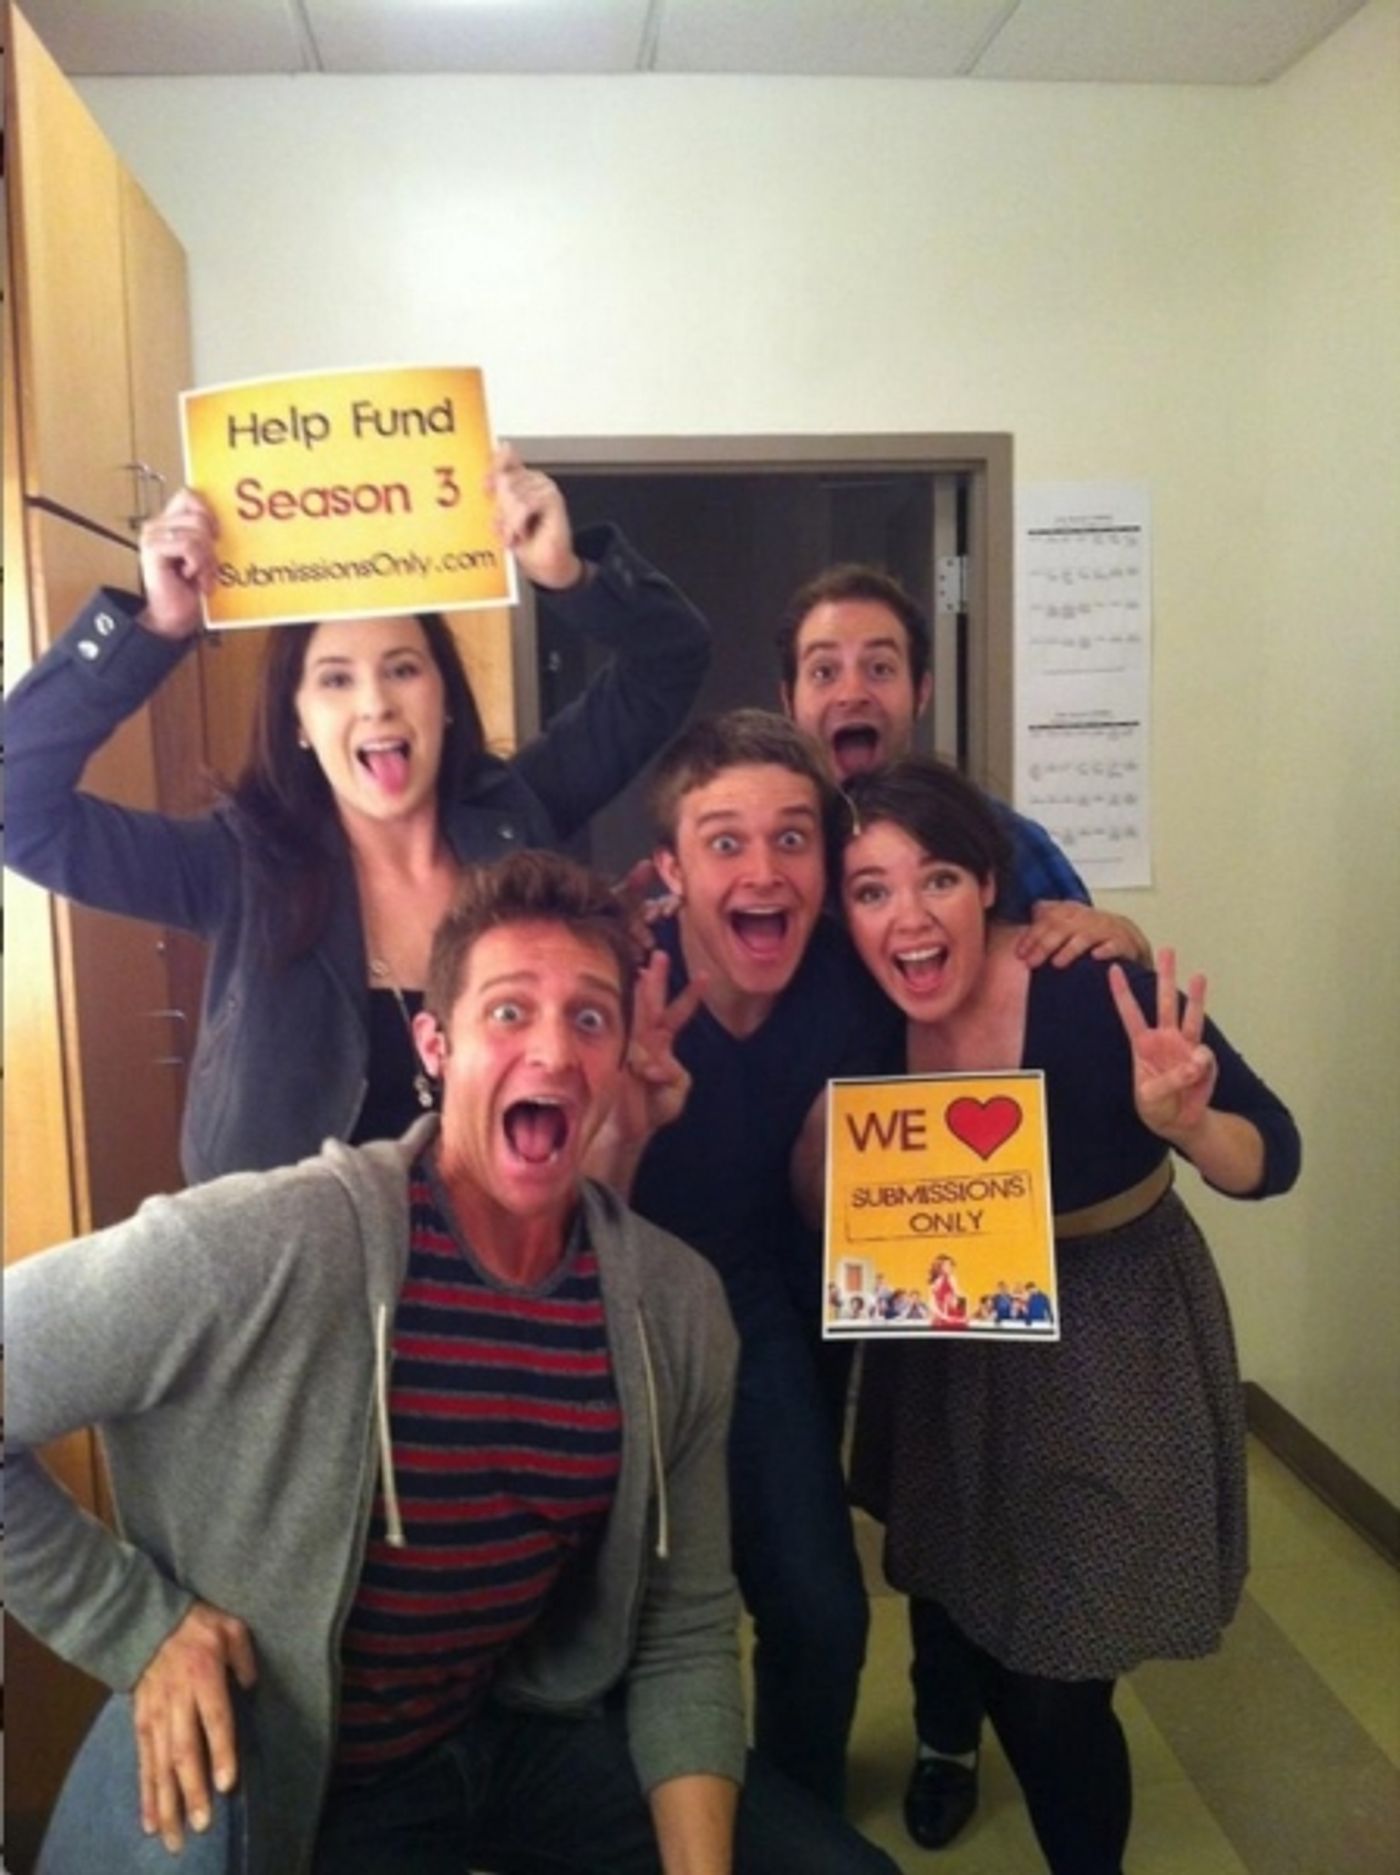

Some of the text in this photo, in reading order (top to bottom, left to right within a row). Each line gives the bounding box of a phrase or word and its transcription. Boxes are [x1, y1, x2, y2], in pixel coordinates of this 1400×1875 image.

[227, 397, 455, 449] Help Fund
[235, 465, 460, 521] Season 3
[218, 549, 496, 588] SubmissionsOnly.com
[846, 1108, 927, 1153] WE
[852, 1174, 1026, 1208] SUBMISSIONS
[909, 1208, 984, 1233] ONLY
